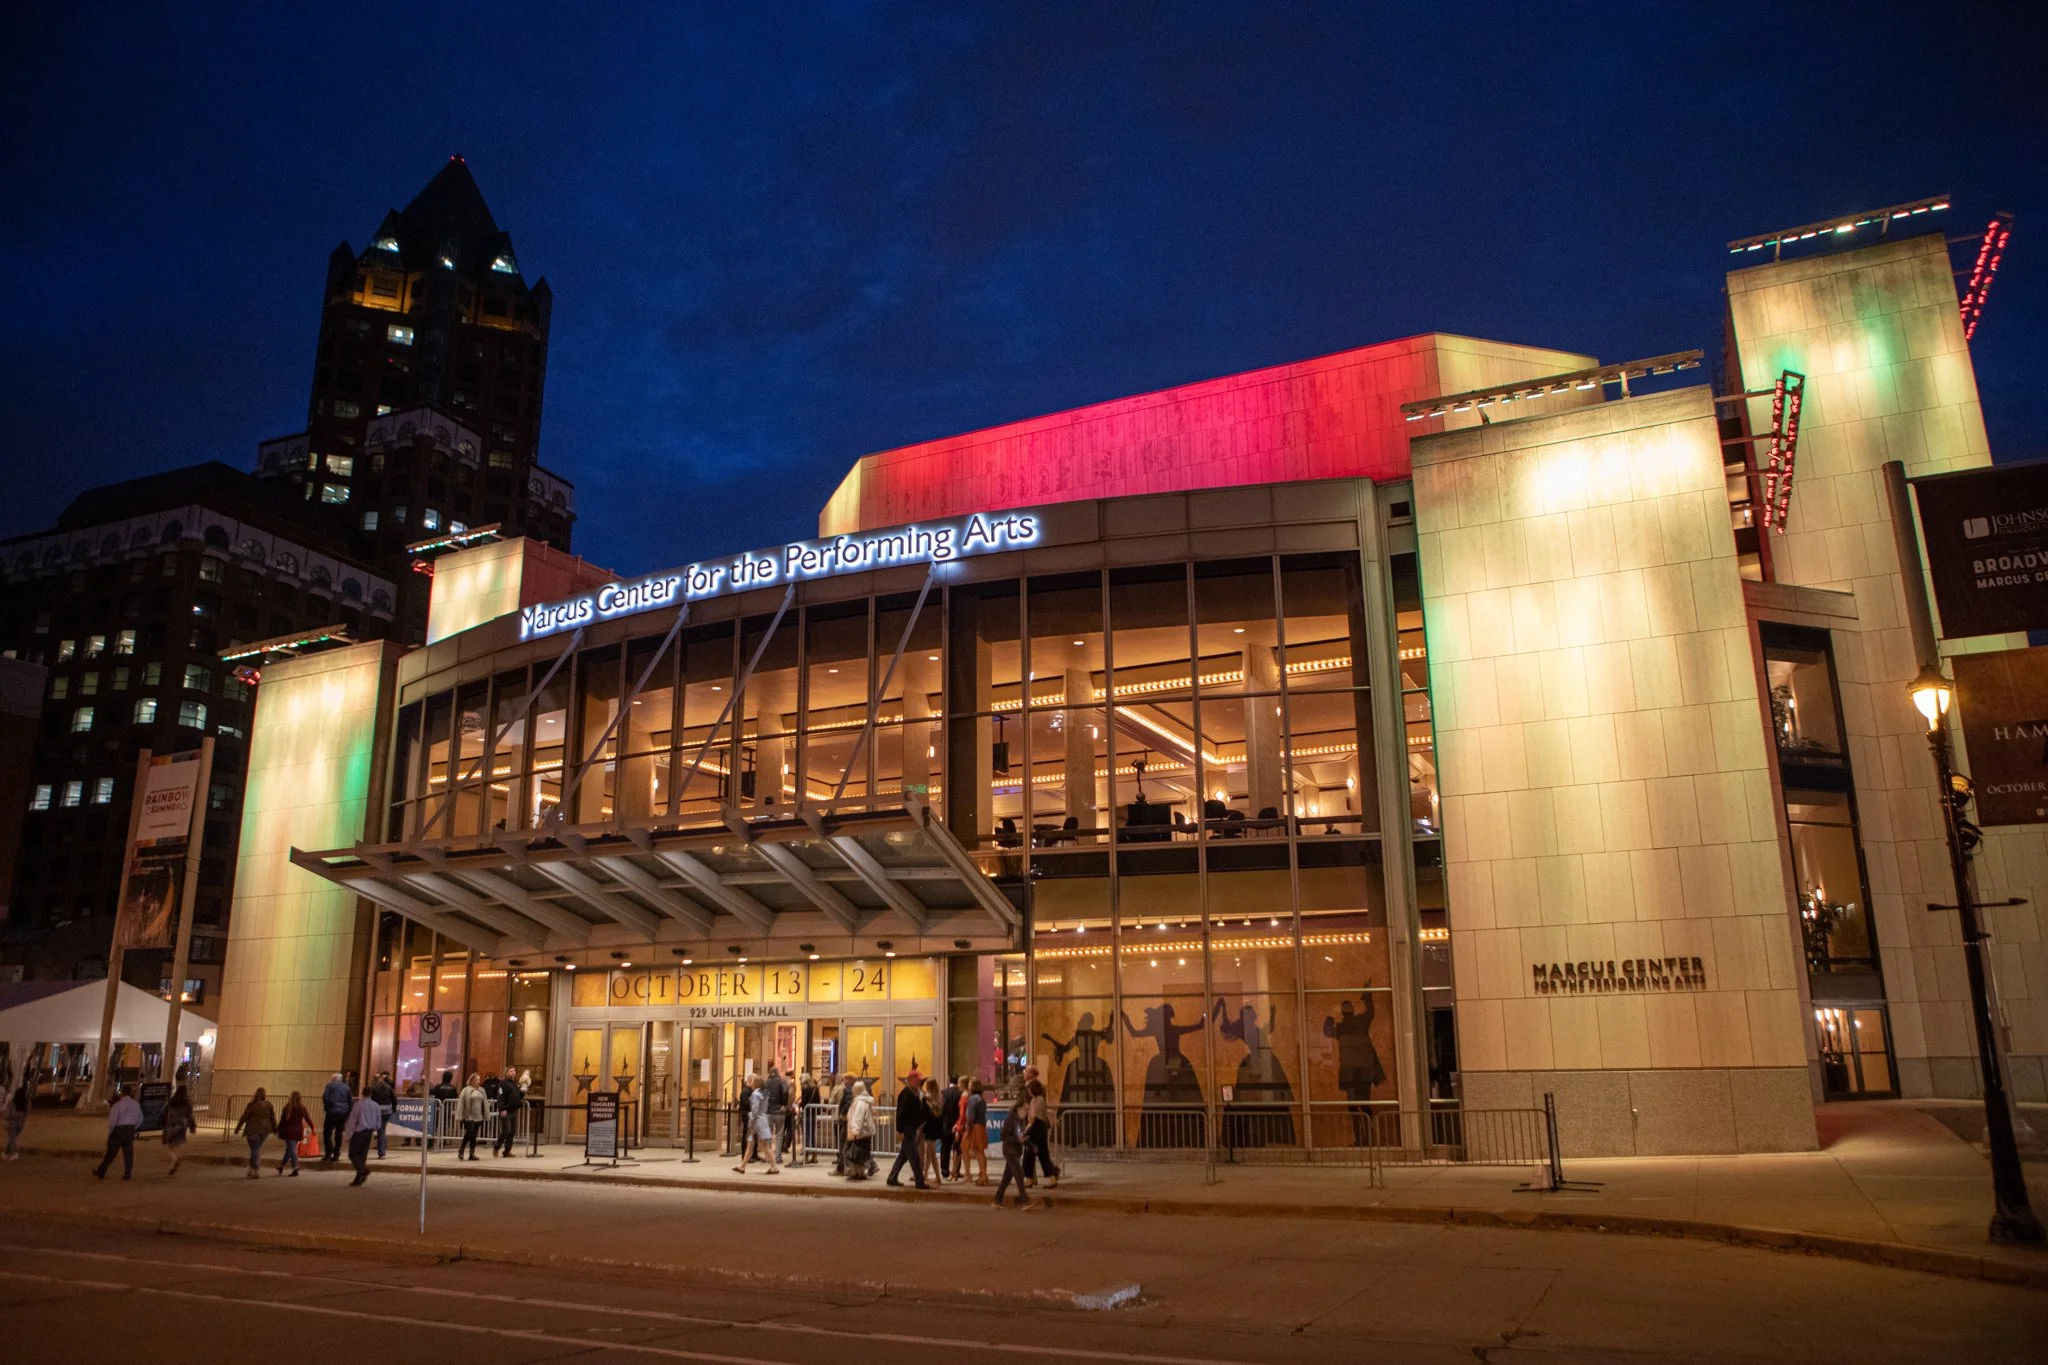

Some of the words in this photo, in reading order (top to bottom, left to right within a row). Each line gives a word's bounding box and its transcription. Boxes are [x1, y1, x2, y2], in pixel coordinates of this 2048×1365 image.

[520, 598, 589, 639] Marcus
[596, 576, 676, 612] Center
[685, 565, 721, 593] for
[730, 554, 773, 583] the
[785, 527, 952, 574] Performing
[963, 515, 1034, 546] Arts
[1977, 574, 2029, 588] MARCUS
[1994, 724, 2048, 740] HAM
[1987, 782, 2047, 794] OCTOBER
[1532, 960, 1616, 978] MARCUS
[1622, 957, 1704, 975] CENTER
[612, 973, 750, 999] OCTOBER
[772, 970, 801, 995] 13
[852, 968, 885, 993] 24
[1534, 979, 1558, 992] FOR
[1560, 978, 1585, 991] THE
[1589, 975, 1669, 990] PERFORMING
[1675, 974, 1706, 985] ARTS
[690, 1007, 707, 1018] 929
[711, 1006, 755, 1018] UIHLEIN
[759, 1005, 789, 1017] HALL
[399, 1114, 432, 1122] ENTRANE
